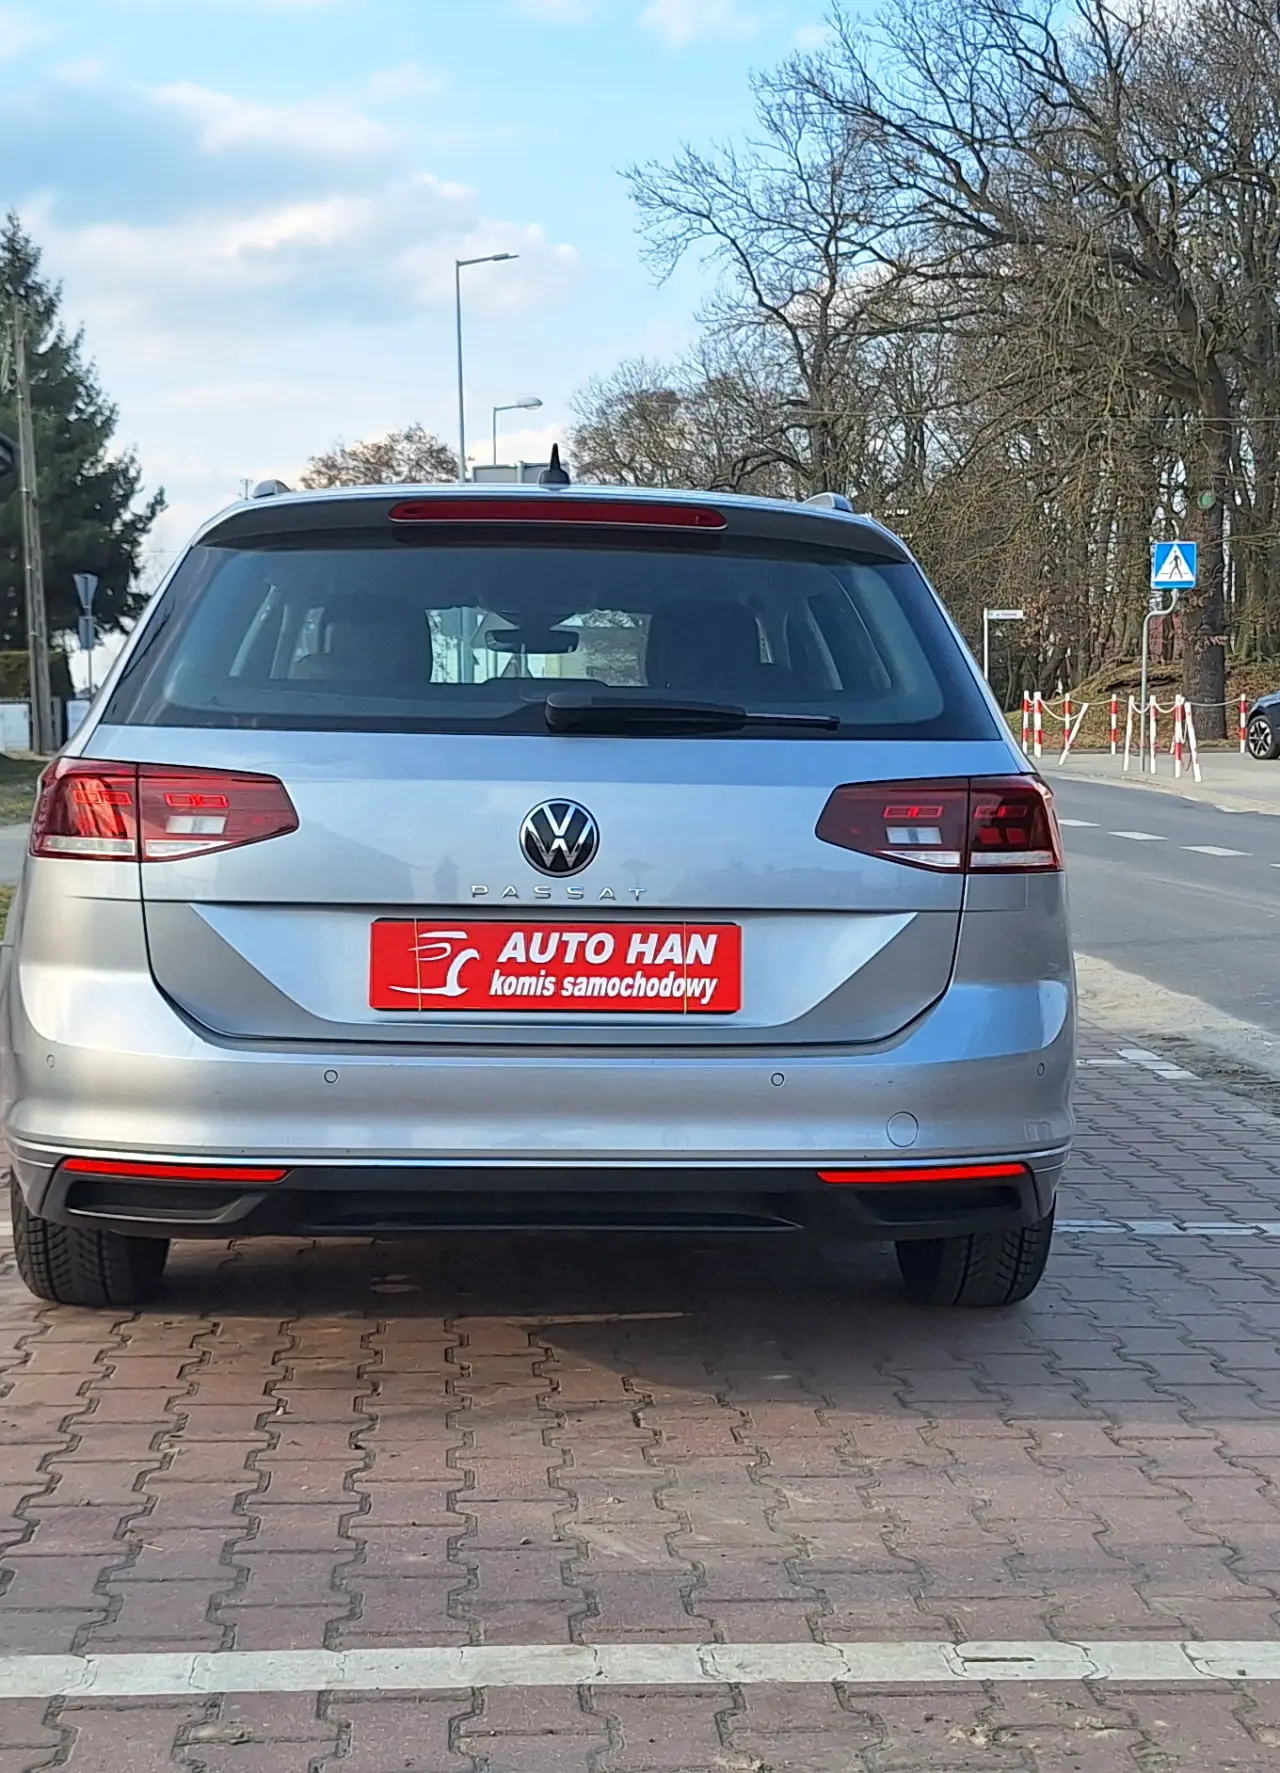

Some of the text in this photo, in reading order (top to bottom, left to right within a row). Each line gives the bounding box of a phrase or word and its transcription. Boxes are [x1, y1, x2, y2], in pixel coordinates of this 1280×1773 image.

[471, 884, 648, 902] PASSAT
[496, 931, 719, 965] AUTO HAN
[488, 968, 719, 1005] komis samochodowy
